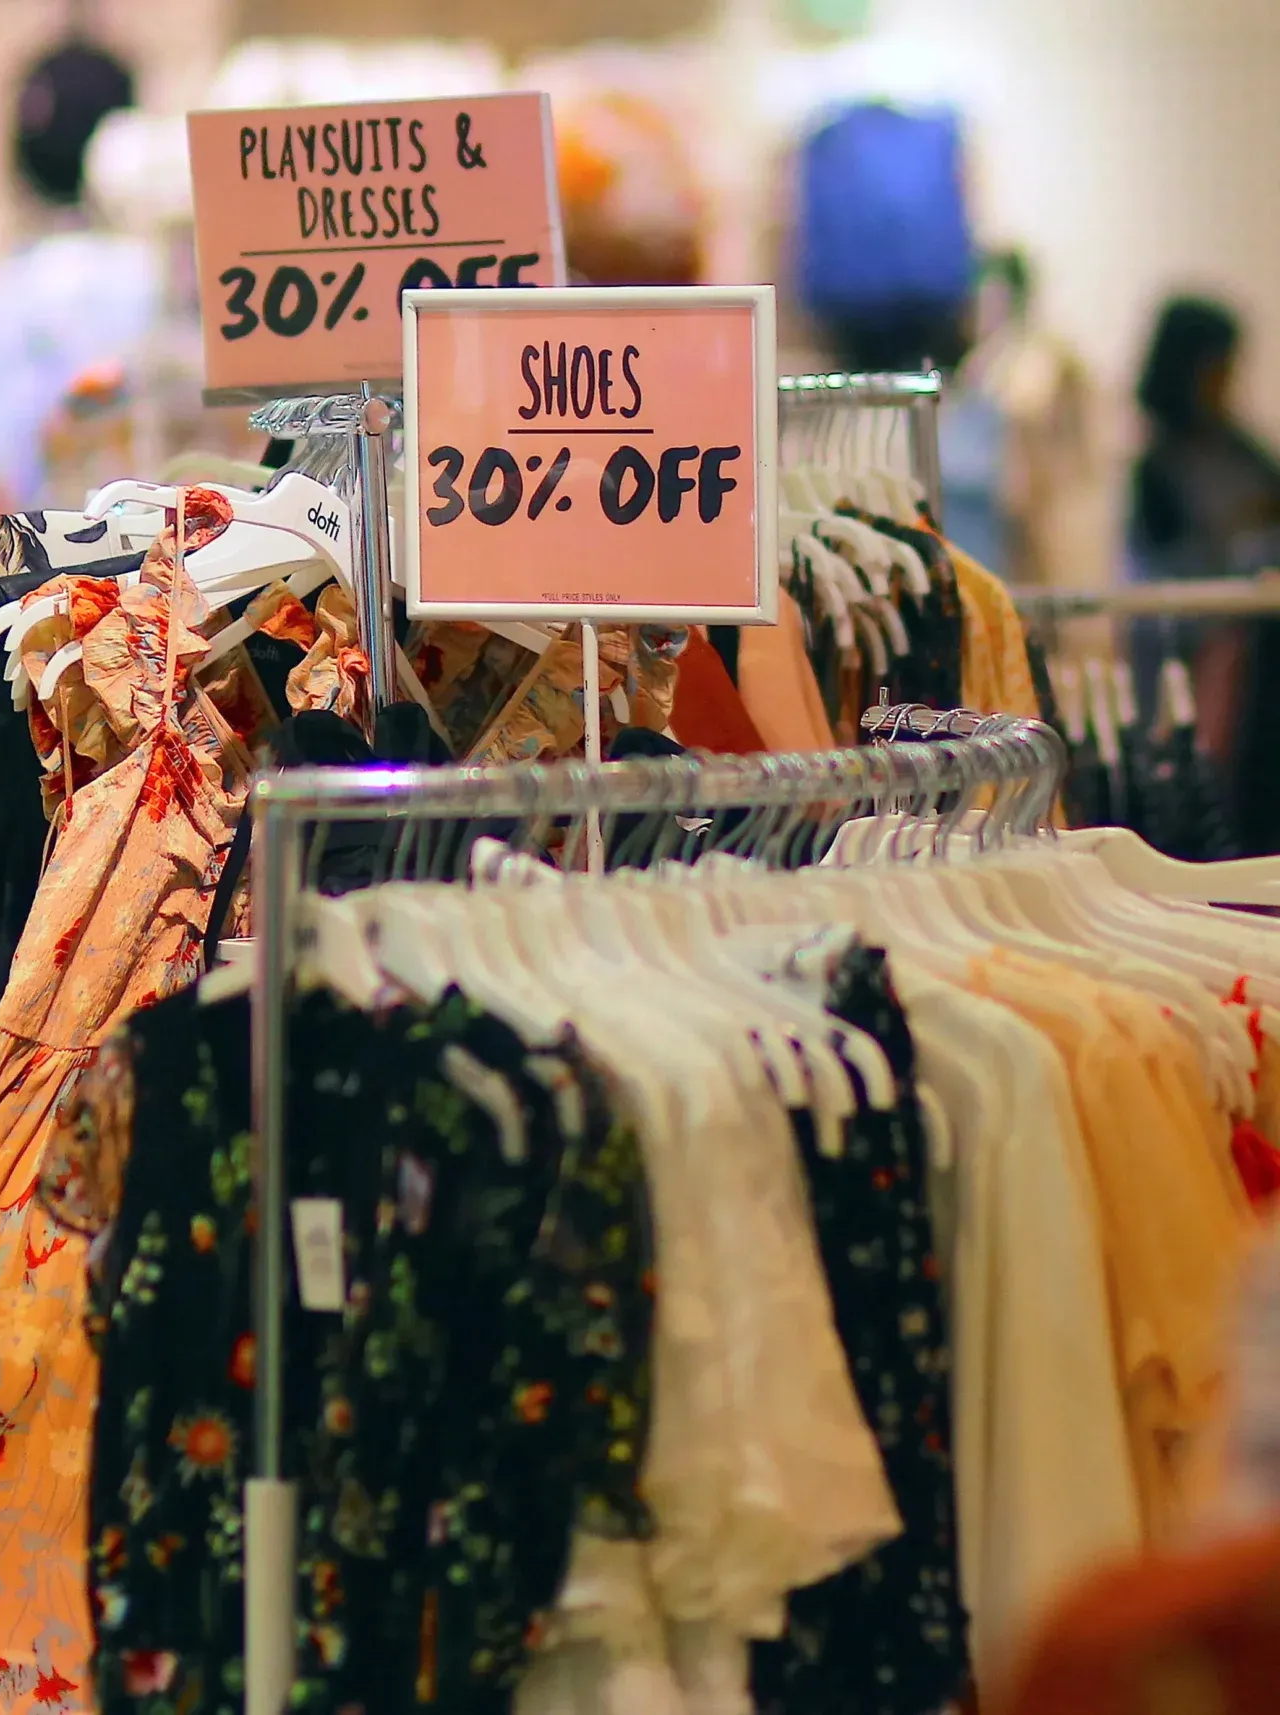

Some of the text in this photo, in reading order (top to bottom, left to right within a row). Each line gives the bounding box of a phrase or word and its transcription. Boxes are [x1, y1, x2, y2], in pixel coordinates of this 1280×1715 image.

[240, 112, 487, 182] PLAYSUITS &
[297, 184, 440, 240] DRESSES
[219, 262, 369, 341] 30%
[519, 341, 641, 420] SHOES
[427, 445, 741, 527] 30% OFF
[307, 501, 341, 542] dotti
[561, 592, 580, 602] PRICE
[582, 592, 604, 602] STYLES
[606, 592, 621, 602] ONLY
